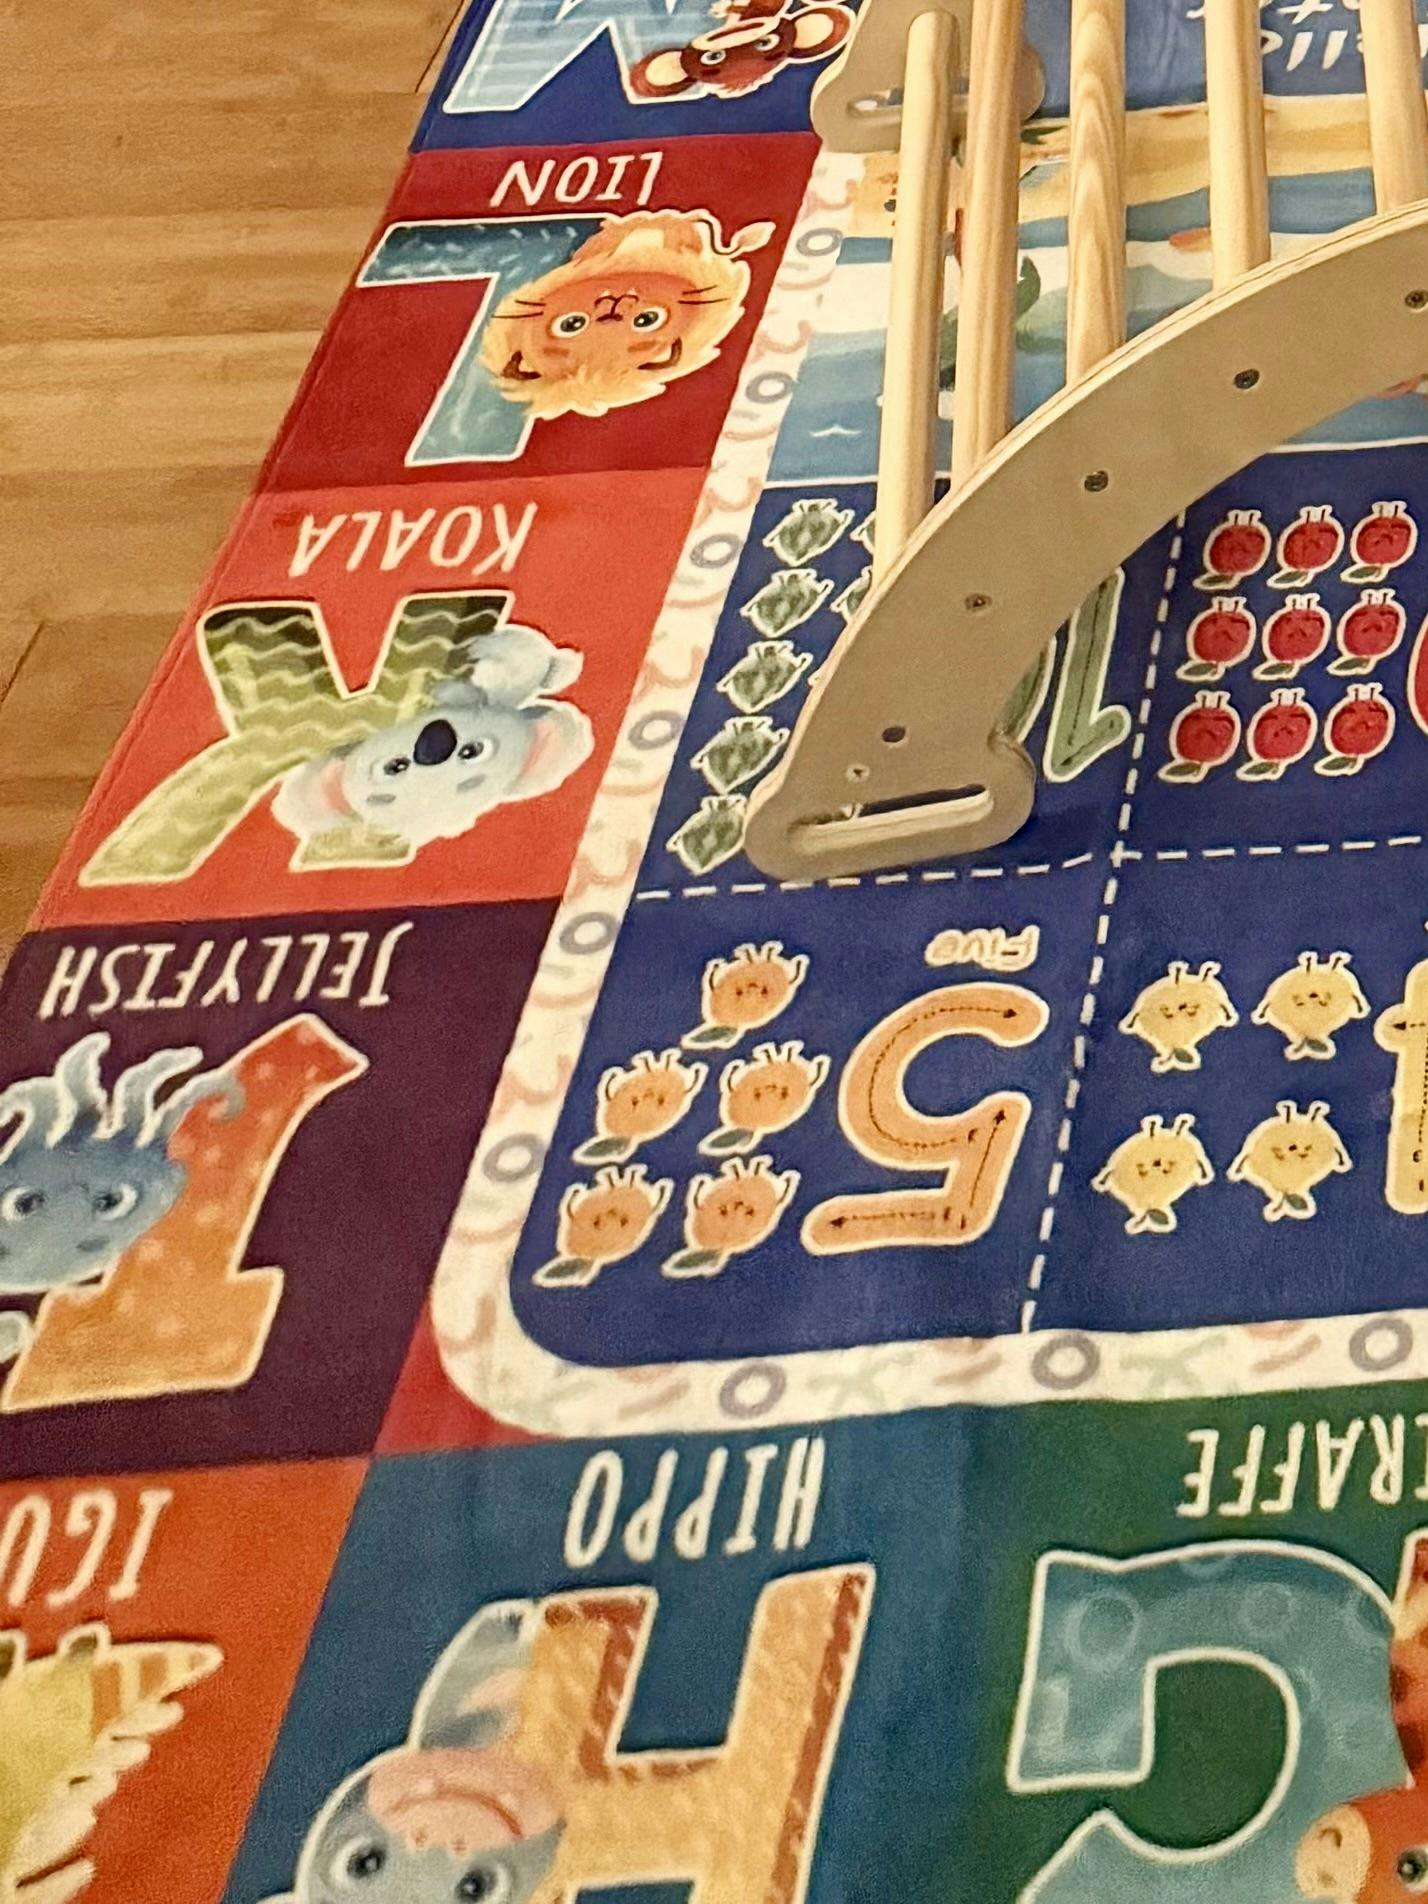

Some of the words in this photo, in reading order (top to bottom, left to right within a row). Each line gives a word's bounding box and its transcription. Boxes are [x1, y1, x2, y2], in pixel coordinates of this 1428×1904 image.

[490, 151, 665, 208] LION
[289, 501, 539, 579] KOALA
[38, 923, 415, 1020] JELLYFISH
[924, 924, 1041, 971] Five
[801, 981, 1052, 1258] 5
[0, 1488, 174, 1608] IGU
[564, 1437, 826, 1570] HIPPO
